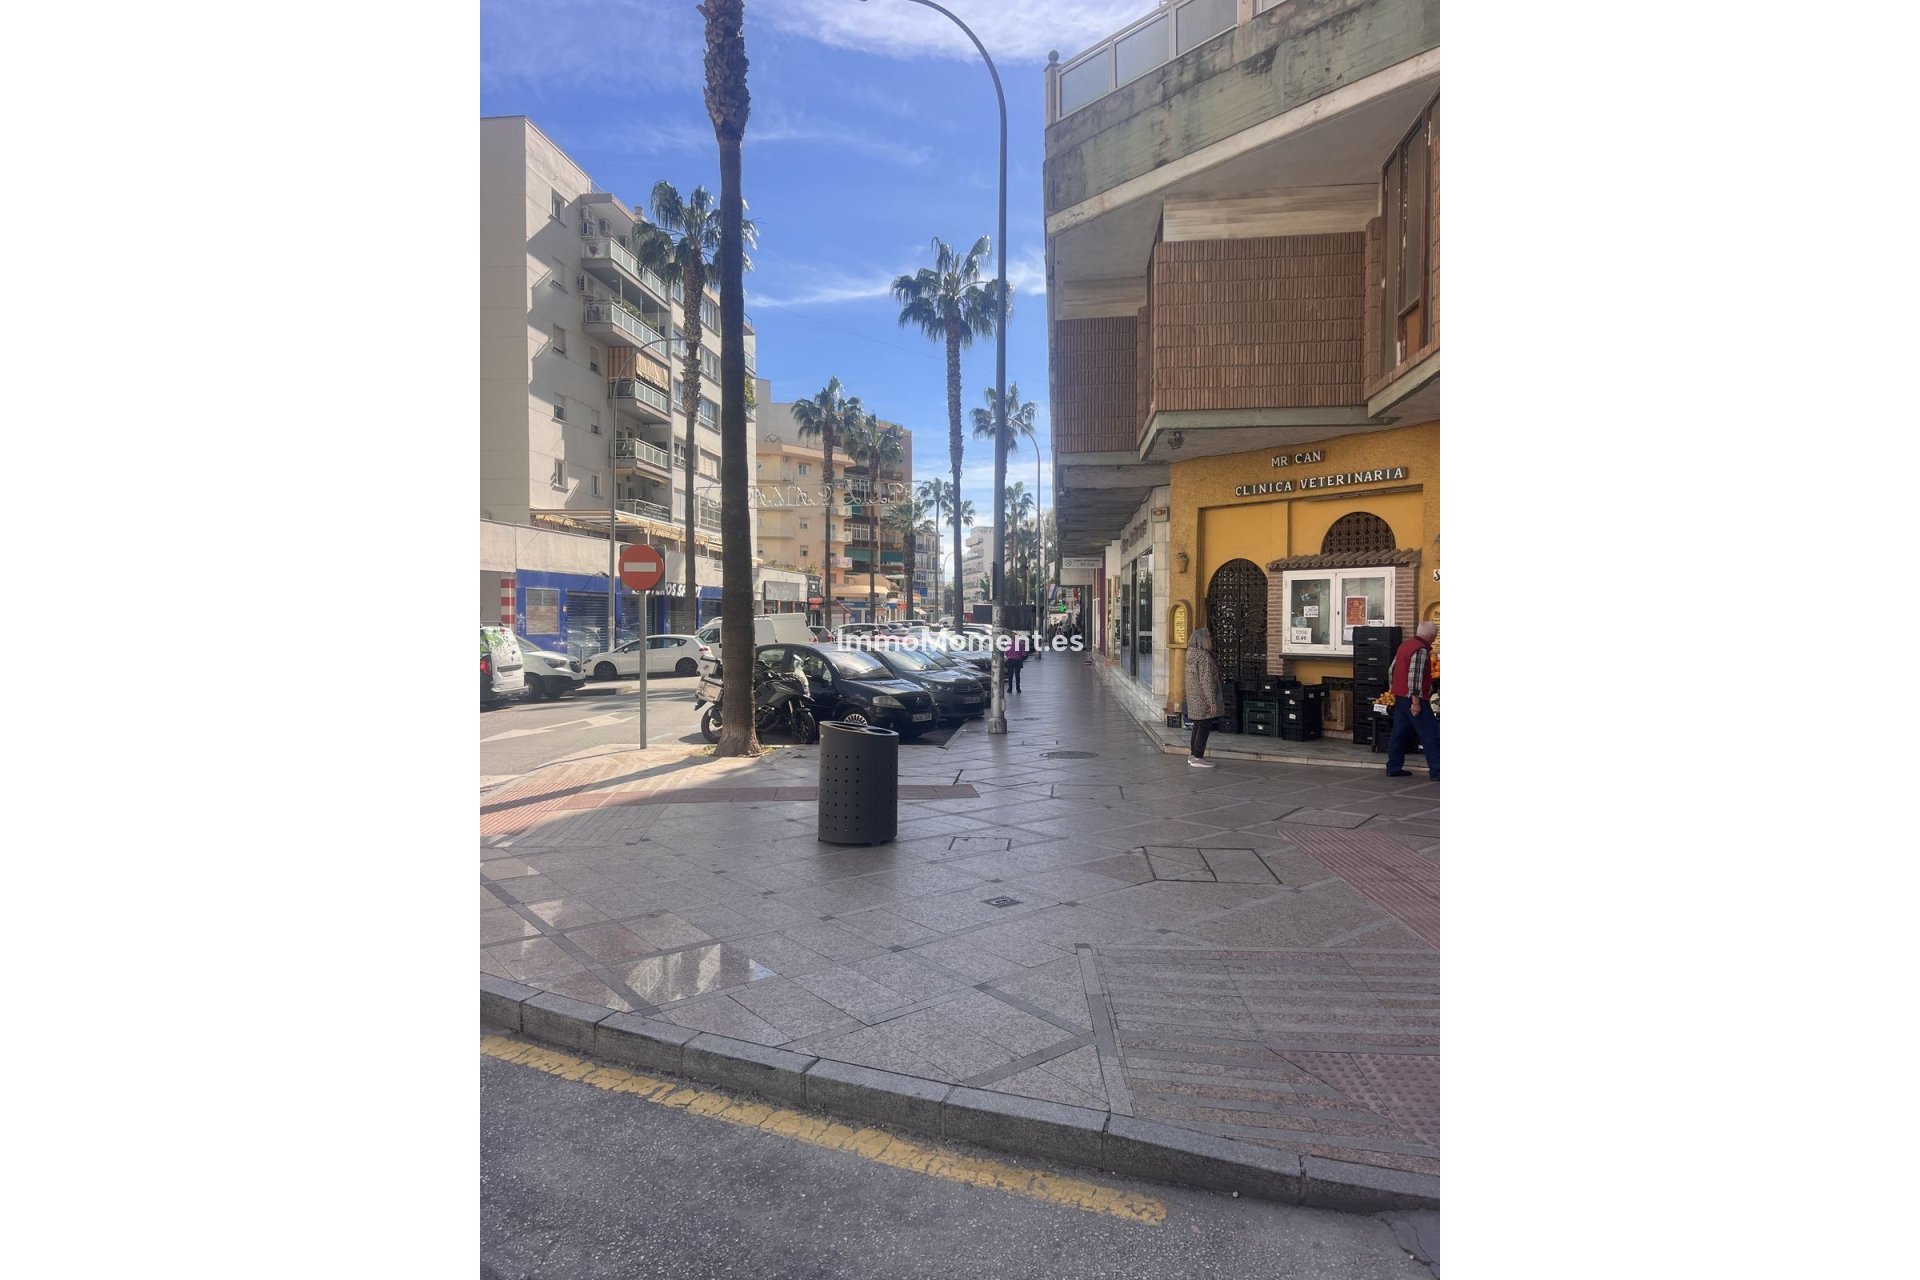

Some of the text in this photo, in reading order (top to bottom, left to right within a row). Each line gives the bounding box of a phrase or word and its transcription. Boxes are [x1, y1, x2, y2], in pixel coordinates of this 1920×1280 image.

[1271, 451, 1321, 467] MR CAN
[1235, 467, 1403, 496] CLINICA VETERINARIA
